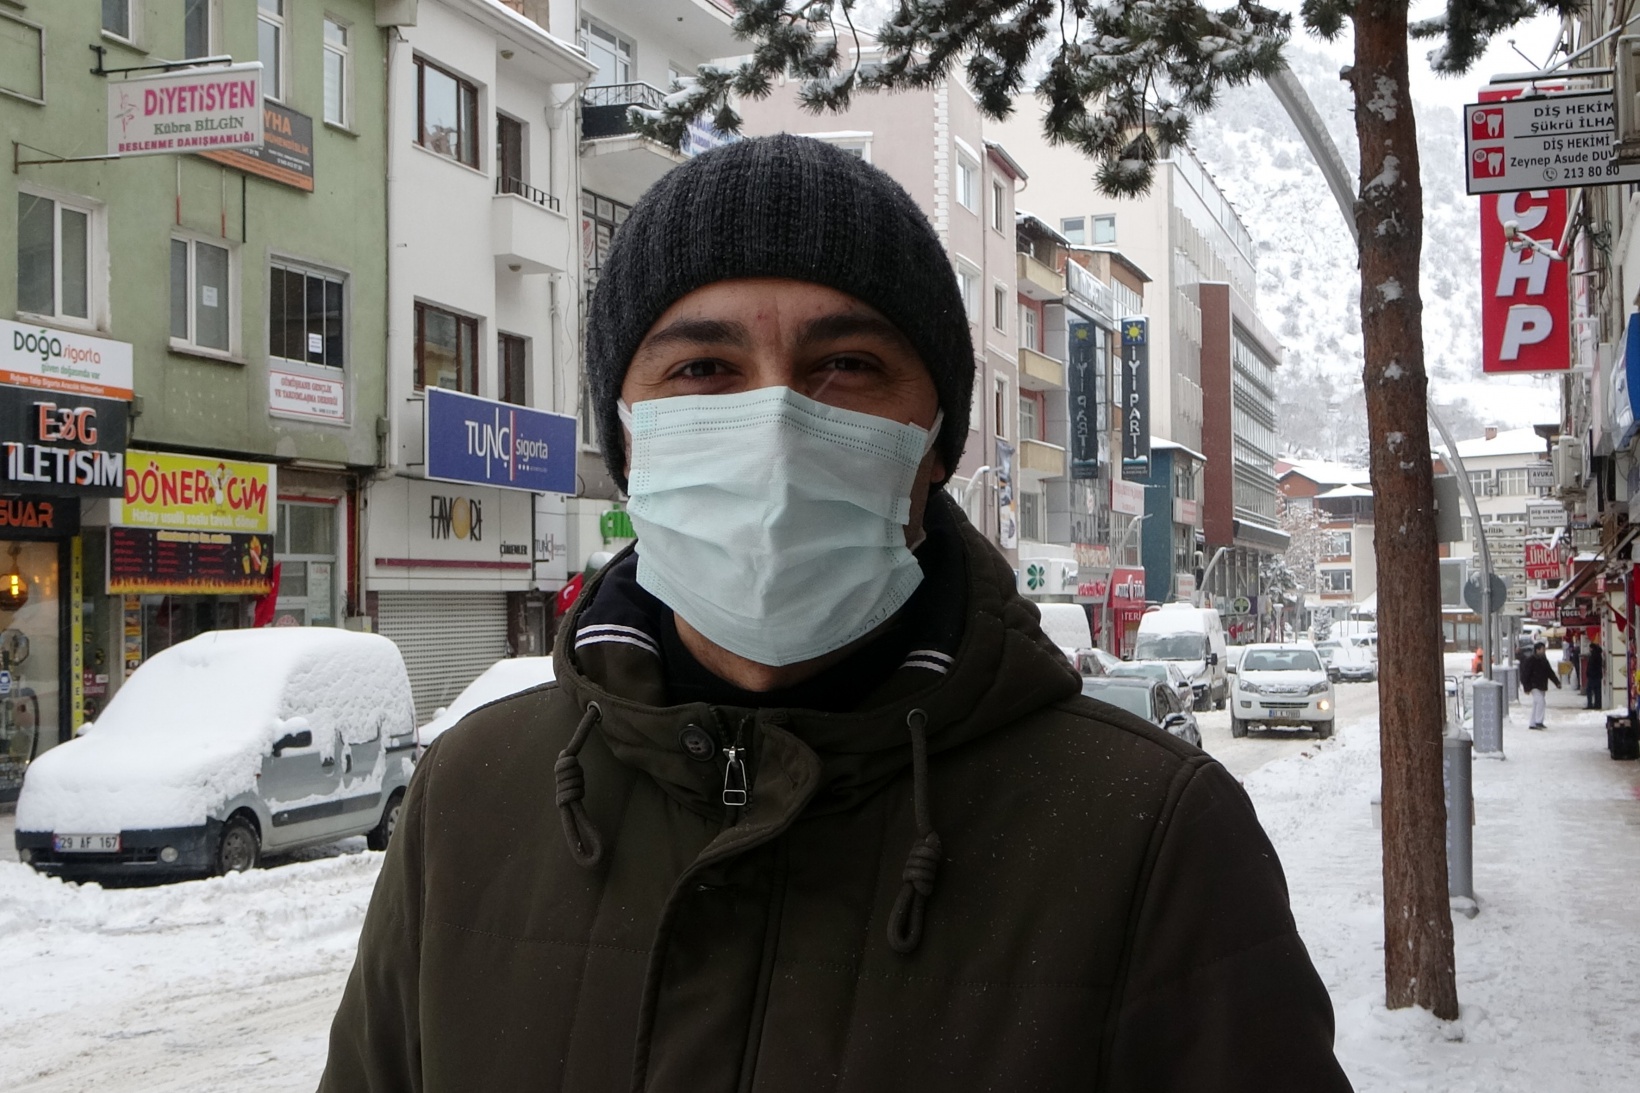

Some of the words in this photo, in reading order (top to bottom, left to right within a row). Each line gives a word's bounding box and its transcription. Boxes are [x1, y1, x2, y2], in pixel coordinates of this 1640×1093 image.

[144, 80, 256, 116] DİYETİSYEN
[1534, 105, 1561, 118] DİŞ
[154, 121, 192, 135] Kübra
[195, 115, 245, 131] BİLGİN
[1530, 119, 1573, 133] Şükrü
[118, 139, 174, 152] BESLENME
[177, 131, 255, 147] DANIŞMANLIĞI
[1543, 138, 1563, 151] DİŞ
[1567, 134, 1610, 149] HEKİMİ
[1510, 155, 1550, 168] Zeynep
[1554, 152, 1588, 164] Asude
[1563, 167, 1584, 179] 213
[1588, 166, 1602, 177] 80
[1605, 164, 1620, 176] 80
[1496, 189, 1553, 360] CHP
[63, 344, 101, 364] sigorta
[38, 403, 97, 445] E&G
[465, 407, 509, 478] TUNÇ
[516, 433, 548, 462] sigorta
[132, 508, 159, 524] Hatay
[62, 836, 73, 849] 29
[80, 836, 92, 849] AF
[100, 835, 118, 849] 167
